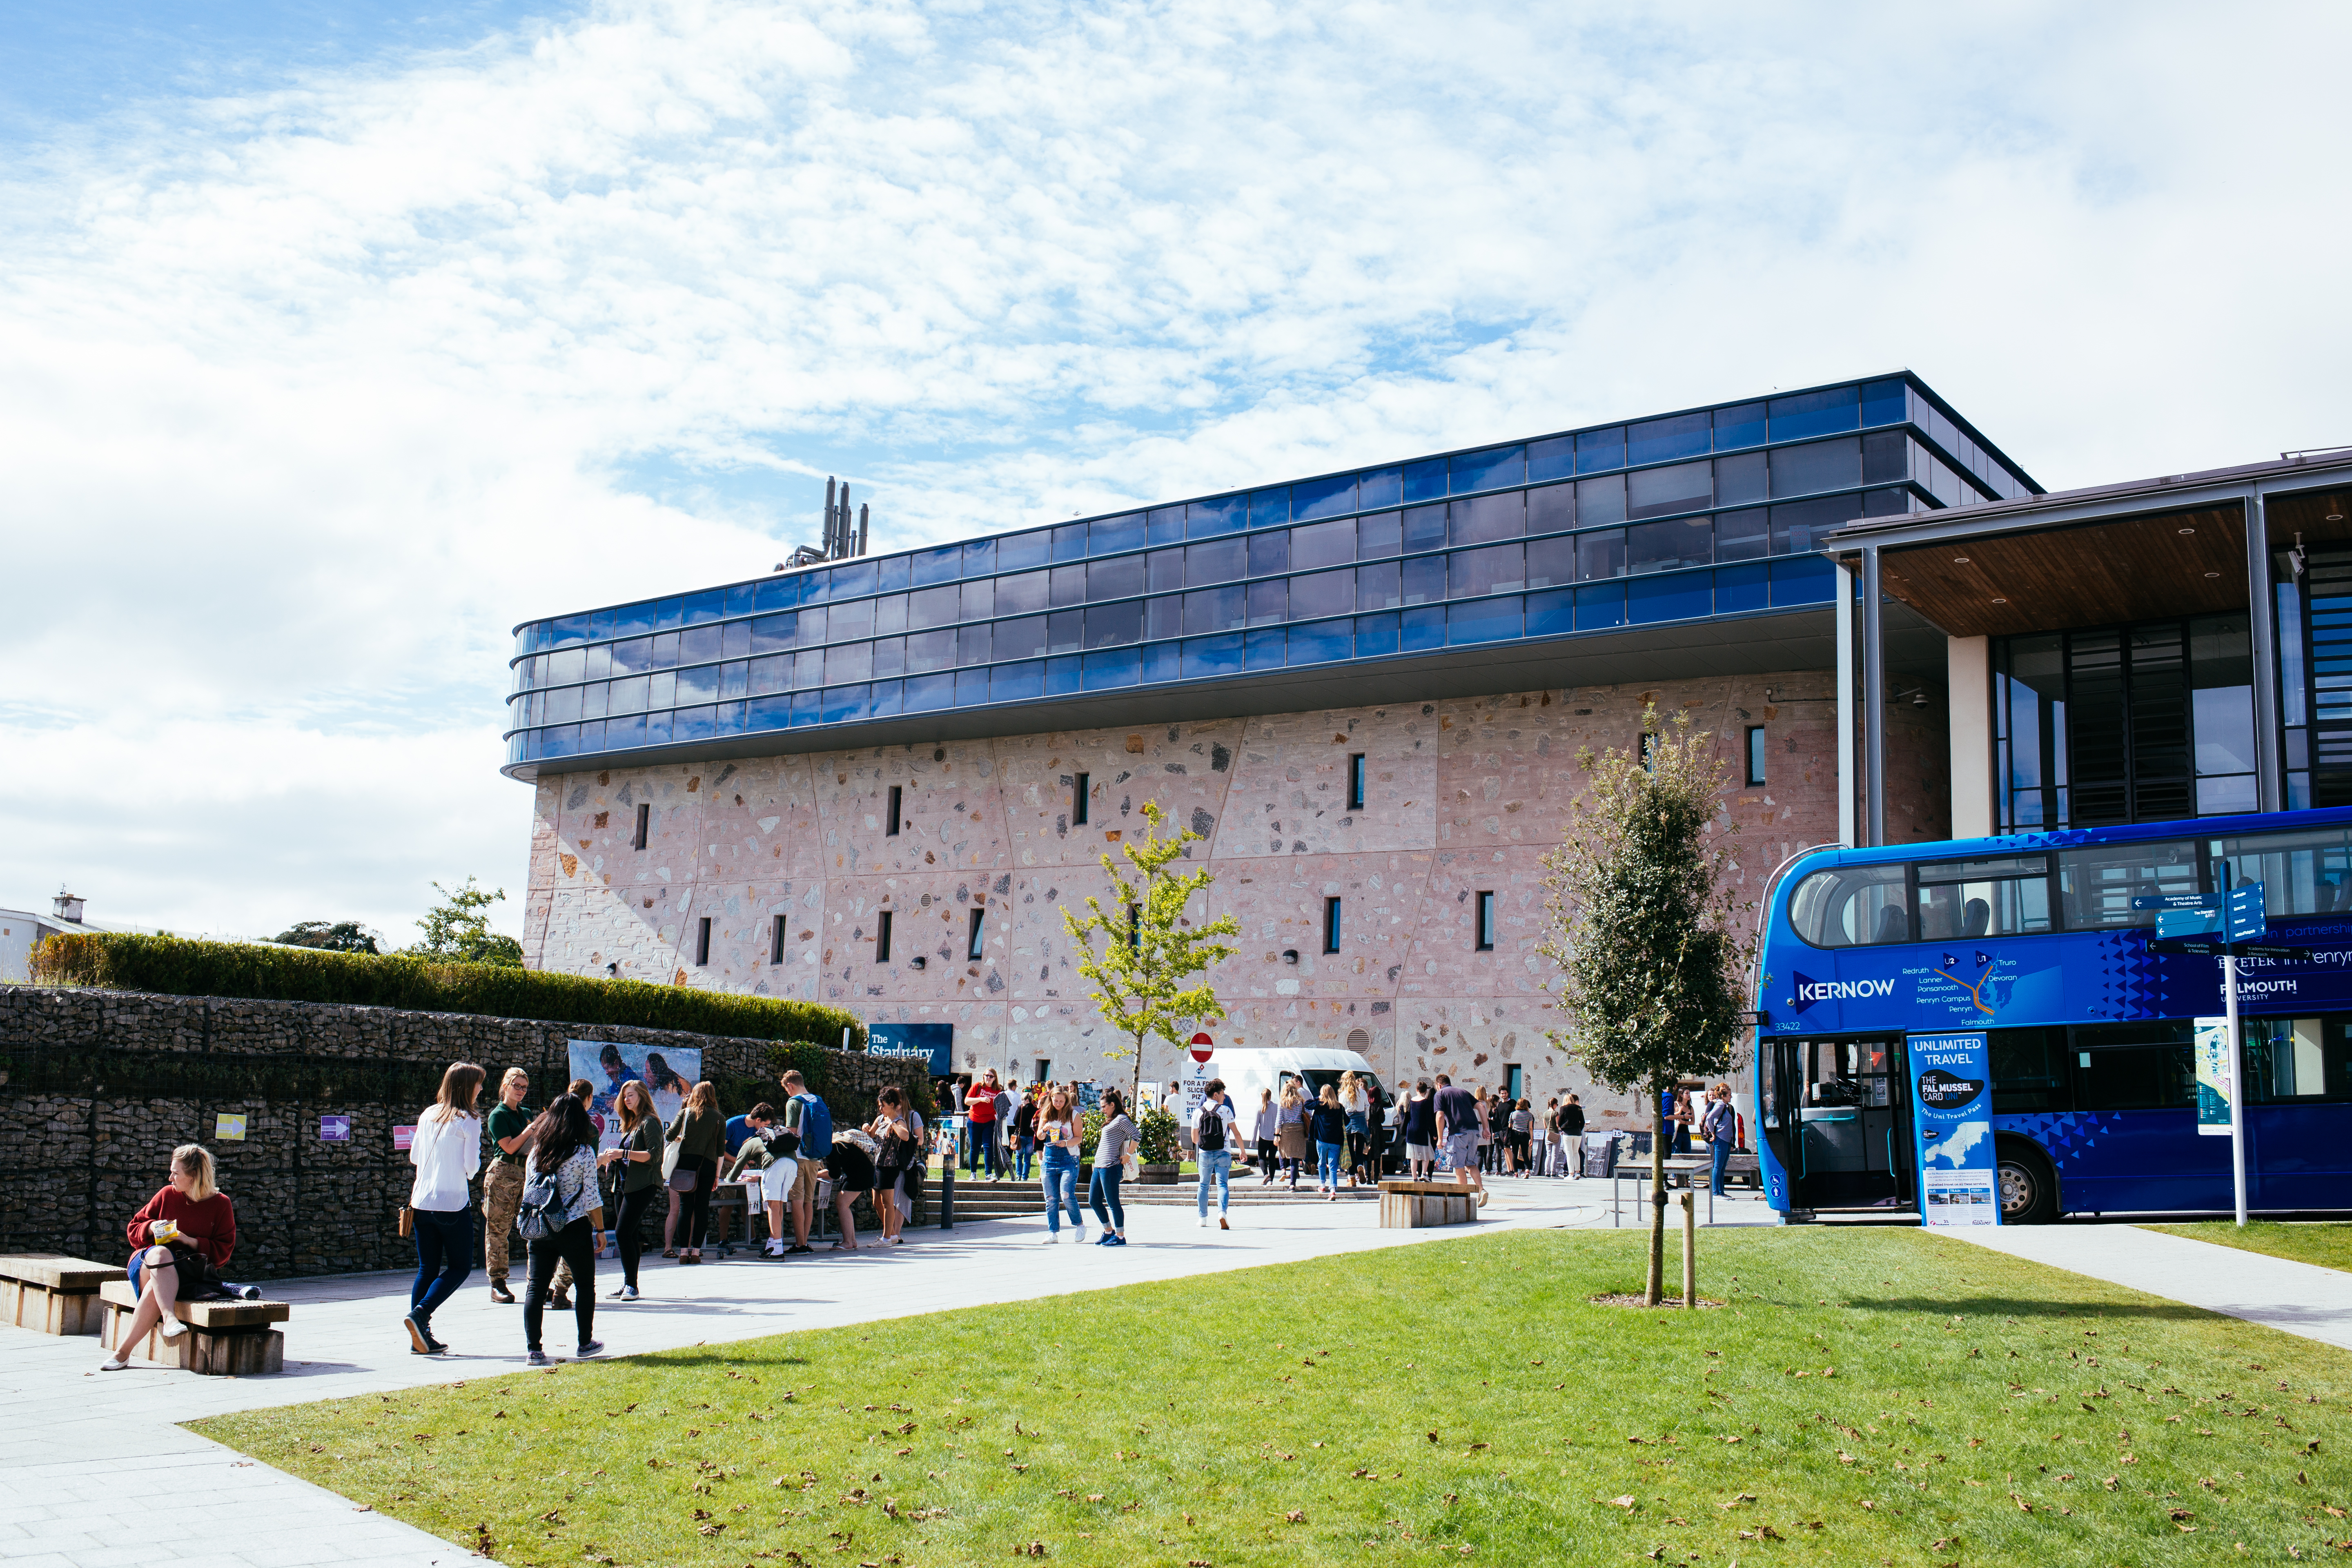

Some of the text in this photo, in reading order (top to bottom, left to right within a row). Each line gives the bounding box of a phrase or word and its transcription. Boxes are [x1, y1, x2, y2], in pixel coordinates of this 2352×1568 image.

[2268, 929, 2278, 938] in
[1799, 979, 1895, 1000] KERNOW
[1918, 984, 1958, 992] Ponsanooth
[2220, 980, 2297, 994] FLMOUTH
[1775, 1022, 1800, 1031] 33422
[872, 1034, 888, 1043] The
[1914, 1038, 1981, 1051] UNLIMITED
[1924, 1053, 1973, 1065] TRAVEL
[1921, 1076, 1937, 1084] THE
[1939, 1083, 1973, 1092] MUSSEL
[1923, 1092, 1943, 1101] CARD
[1921, 1107, 1932, 1117] The
[1947, 1111, 1967, 1119] Travel
[1967, 1103, 1981, 1114] Pass
